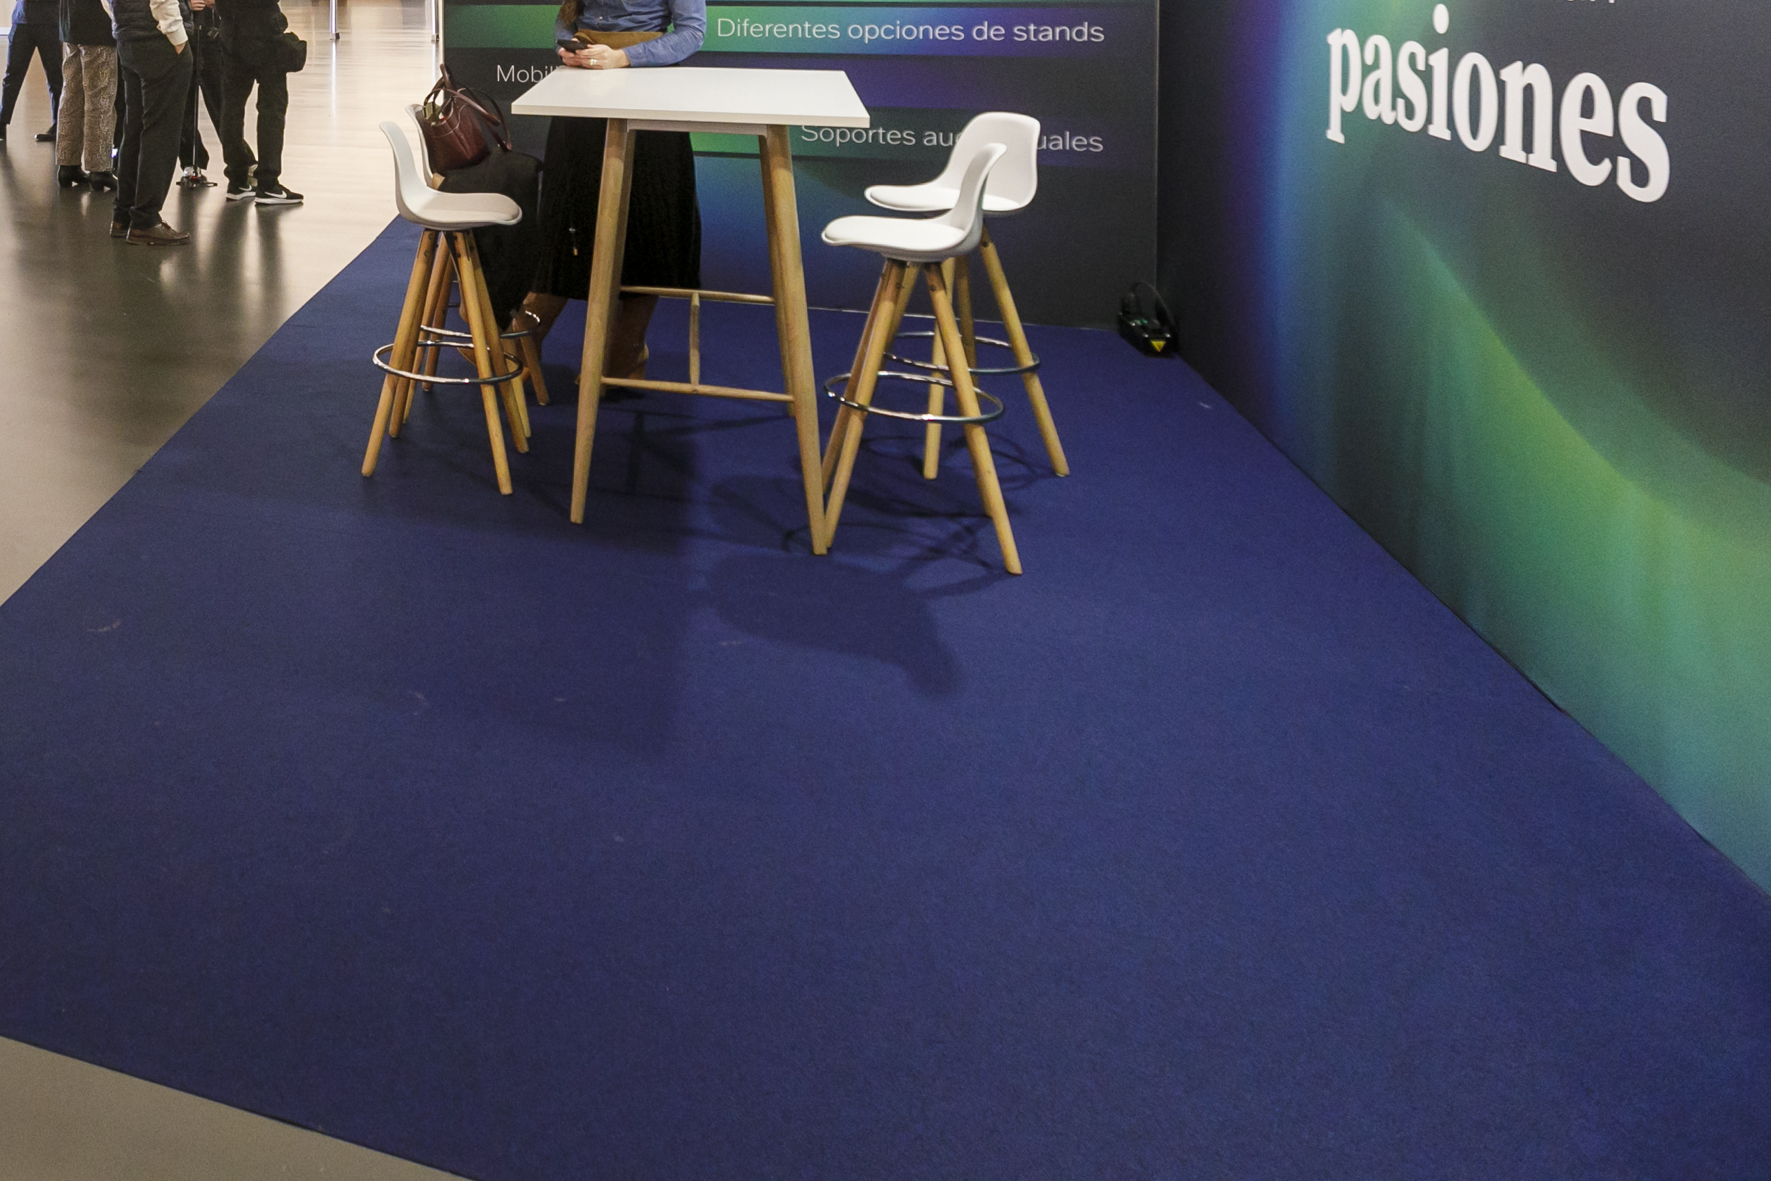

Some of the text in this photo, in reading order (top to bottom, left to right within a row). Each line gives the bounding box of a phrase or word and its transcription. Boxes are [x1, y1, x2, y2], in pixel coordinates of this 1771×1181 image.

[717, 17, 1105, 44] Diferentes opciones de stands
[1326, 3, 1671, 203] pasiones
[801, 125, 916, 147] Soportes
